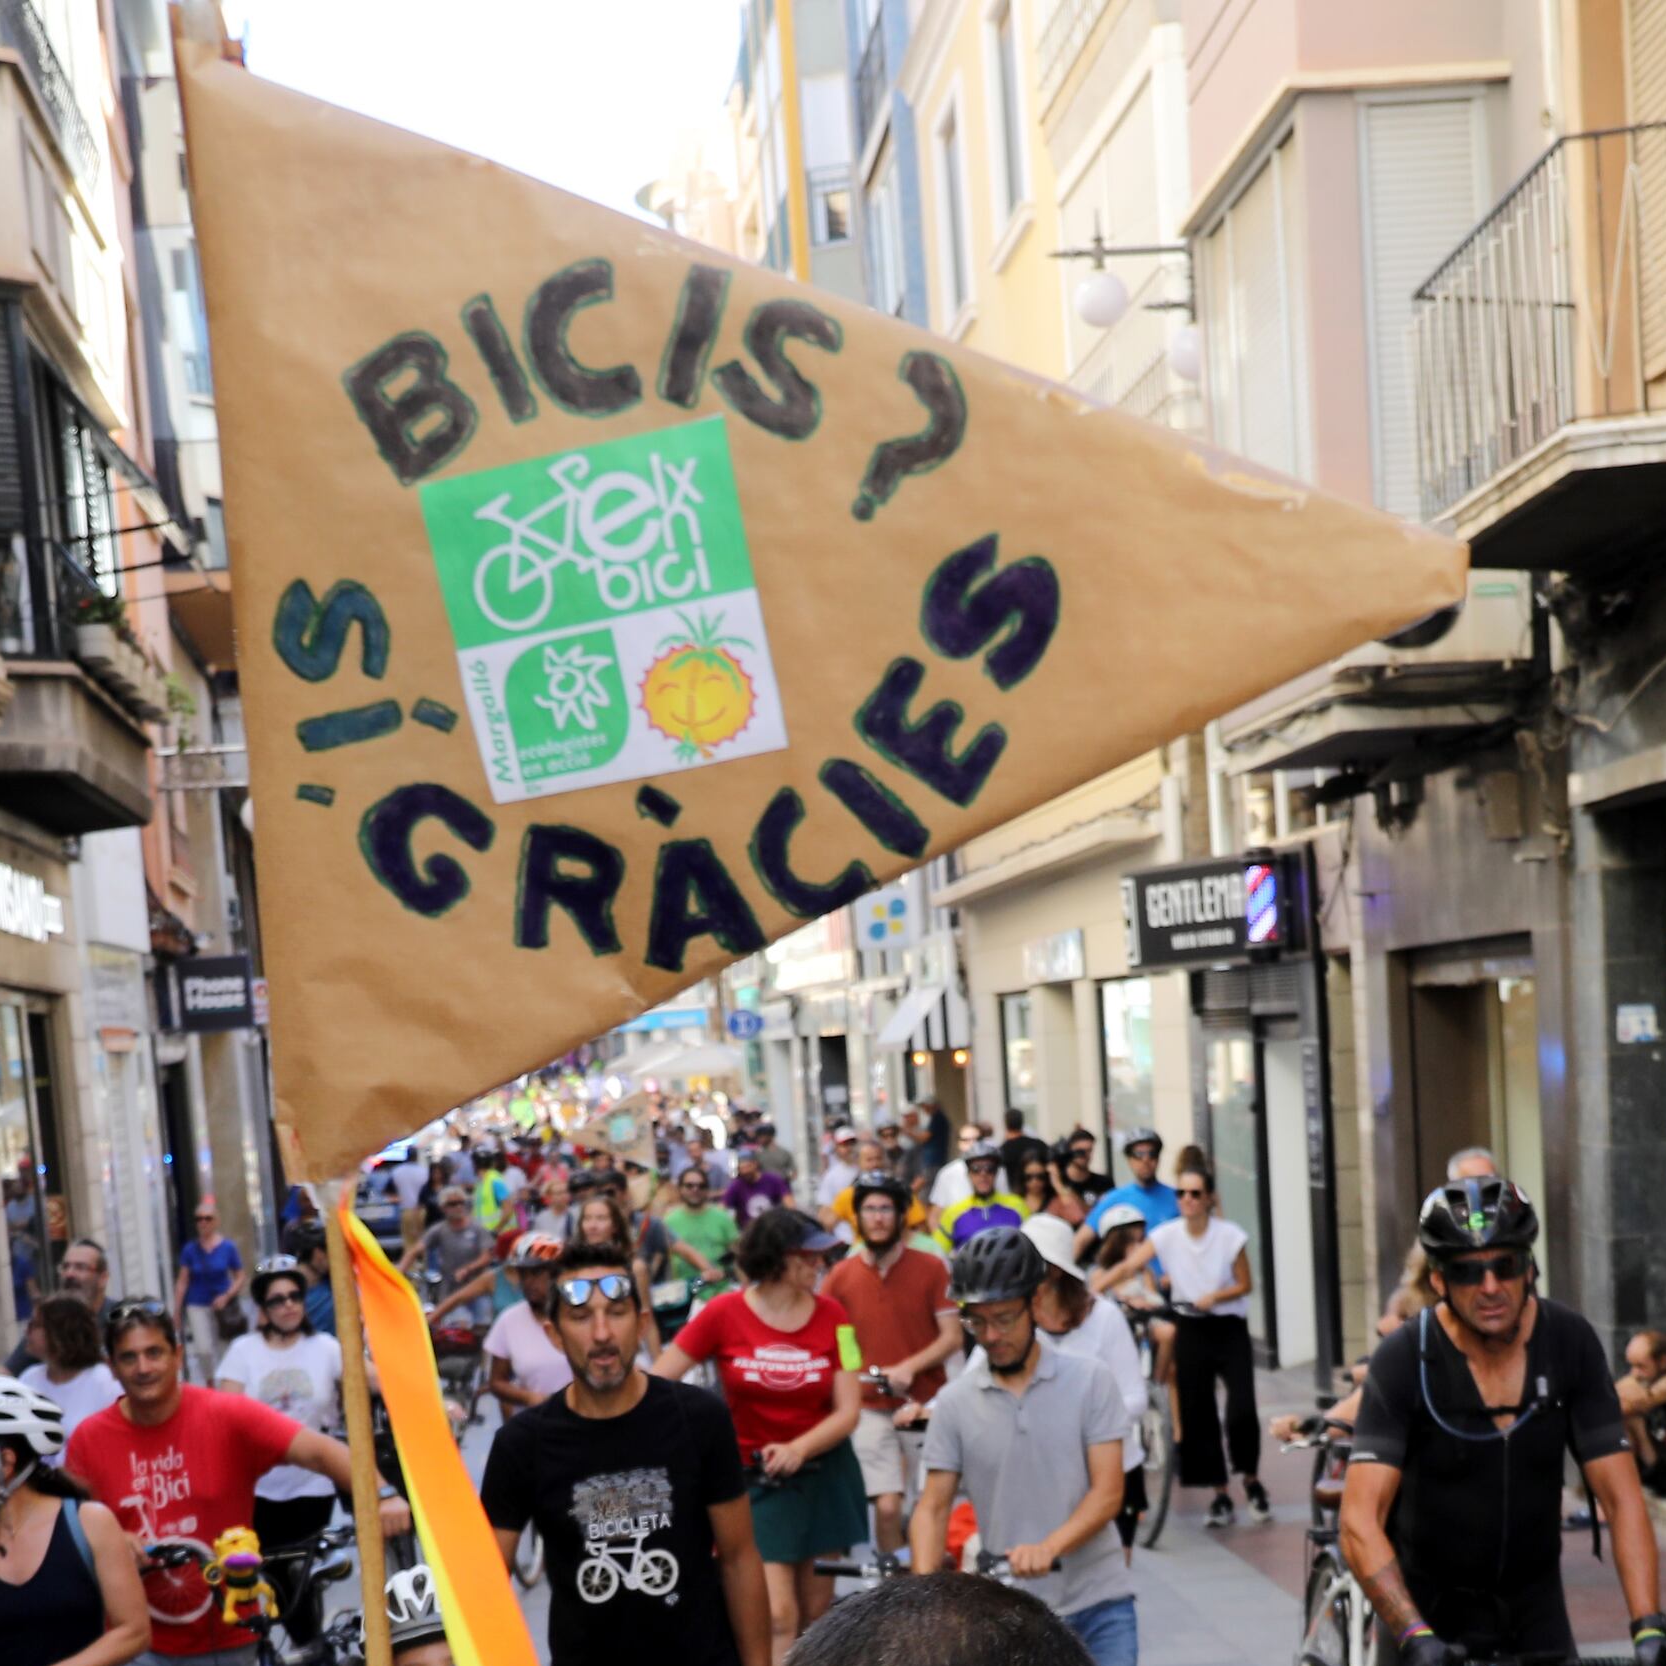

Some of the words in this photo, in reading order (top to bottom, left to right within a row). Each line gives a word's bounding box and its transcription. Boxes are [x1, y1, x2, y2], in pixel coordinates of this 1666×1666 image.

[467, 660, 515, 784] Margalló
[359, 532, 1063, 974] GRÀCIES
[518, 733, 608, 763] ecologistes
[1145, 871, 1246, 929] GENTLEMA
[184, 976, 245, 993] Phone
[130, 1451, 147, 1475] la
[151, 1446, 184, 1473] vida
[152, 1472, 191, 1510] Bici
[588, 1512, 671, 1540] BICICLETA
